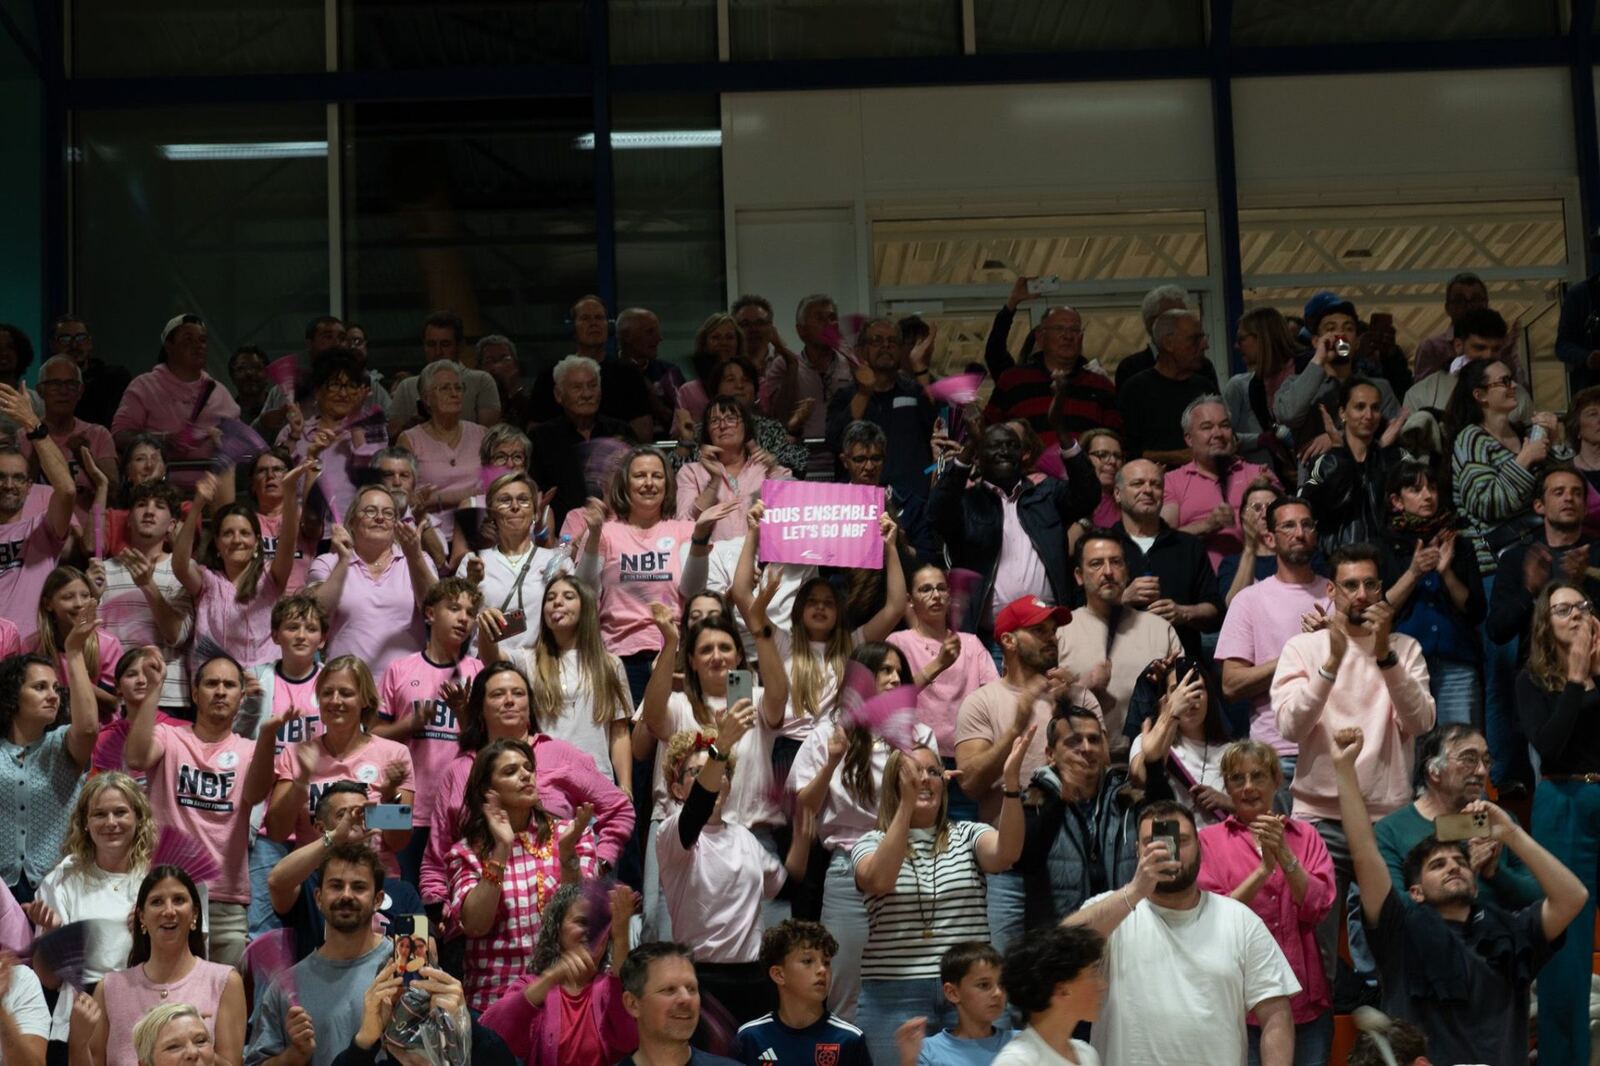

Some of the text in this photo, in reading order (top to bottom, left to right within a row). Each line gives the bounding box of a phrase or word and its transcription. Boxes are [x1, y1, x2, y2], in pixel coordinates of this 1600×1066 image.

[762, 504, 878, 524] TOUS ENSEMBLE
[783, 523, 868, 540] LET'S GO NBF
[620, 551, 671, 572] NBF
[178, 765, 235, 799] NBF
